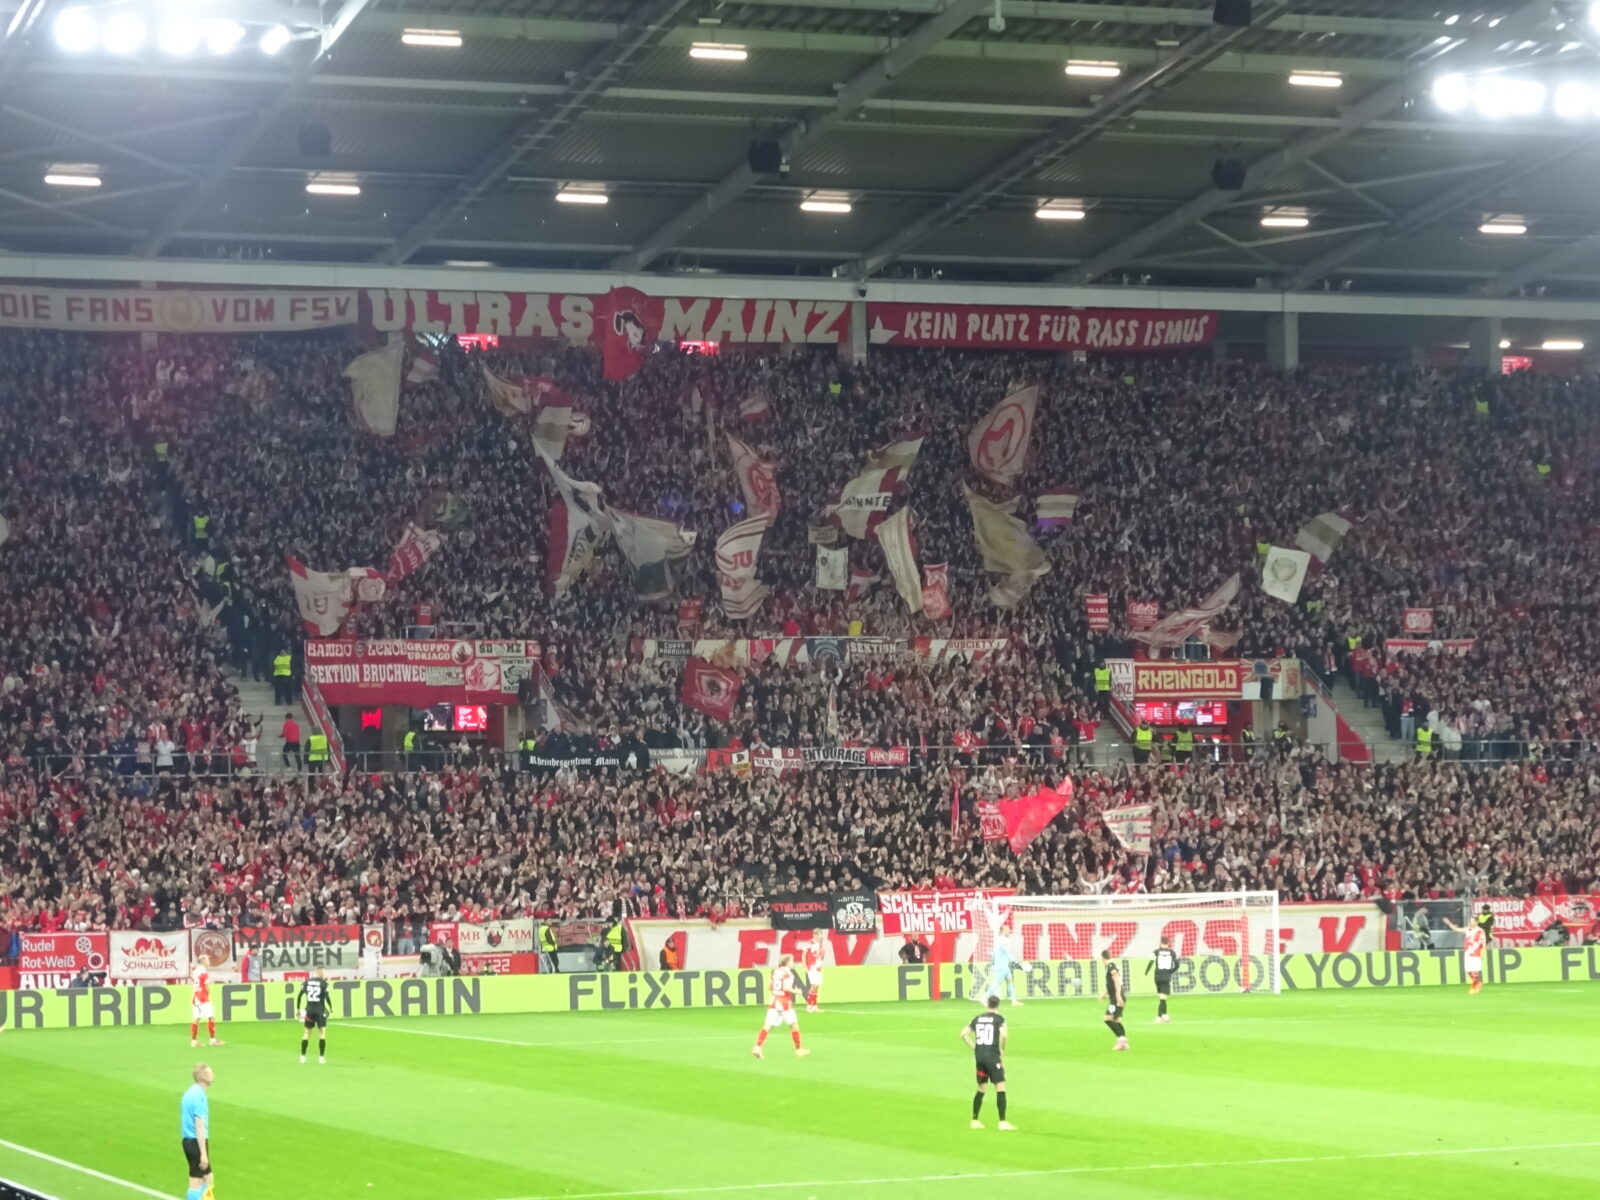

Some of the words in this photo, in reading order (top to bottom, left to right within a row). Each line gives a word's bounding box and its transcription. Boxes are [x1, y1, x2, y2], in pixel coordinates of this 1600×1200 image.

[66, 297, 153, 322] FANS
[212, 298, 275, 323] VOM
[289, 296, 351, 321] FSV
[366, 289, 594, 338] ULTRAS
[659, 299, 847, 343] MAINZ
[904, 311, 957, 340] KEIN
[967, 313, 1030, 342] PLATZ
[1038, 315, 1081, 344] FÜR
[407, 643, 450, 653] GRUPPO
[310, 664, 360, 684] SEKTION
[362, 663, 426, 683] BRUCHWEG
[804, 748, 865, 763] ENTOURAGE
[21, 937, 55, 952] Rudel
[21, 954, 76, 970] Rot-Weiß
[121, 960, 178, 972] SCHNAUZER
[261, 948, 343, 968] RAUEN
[1304, 950, 1421, 989] YOUR
[221, 977, 482, 1021] FLiTRAIN
[306, 985, 321, 1002] 22
[569, 968, 812, 1011] FLiXTRAN
[56, 987, 172, 1027] TRIP
[975, 1023, 994, 1046] 50
